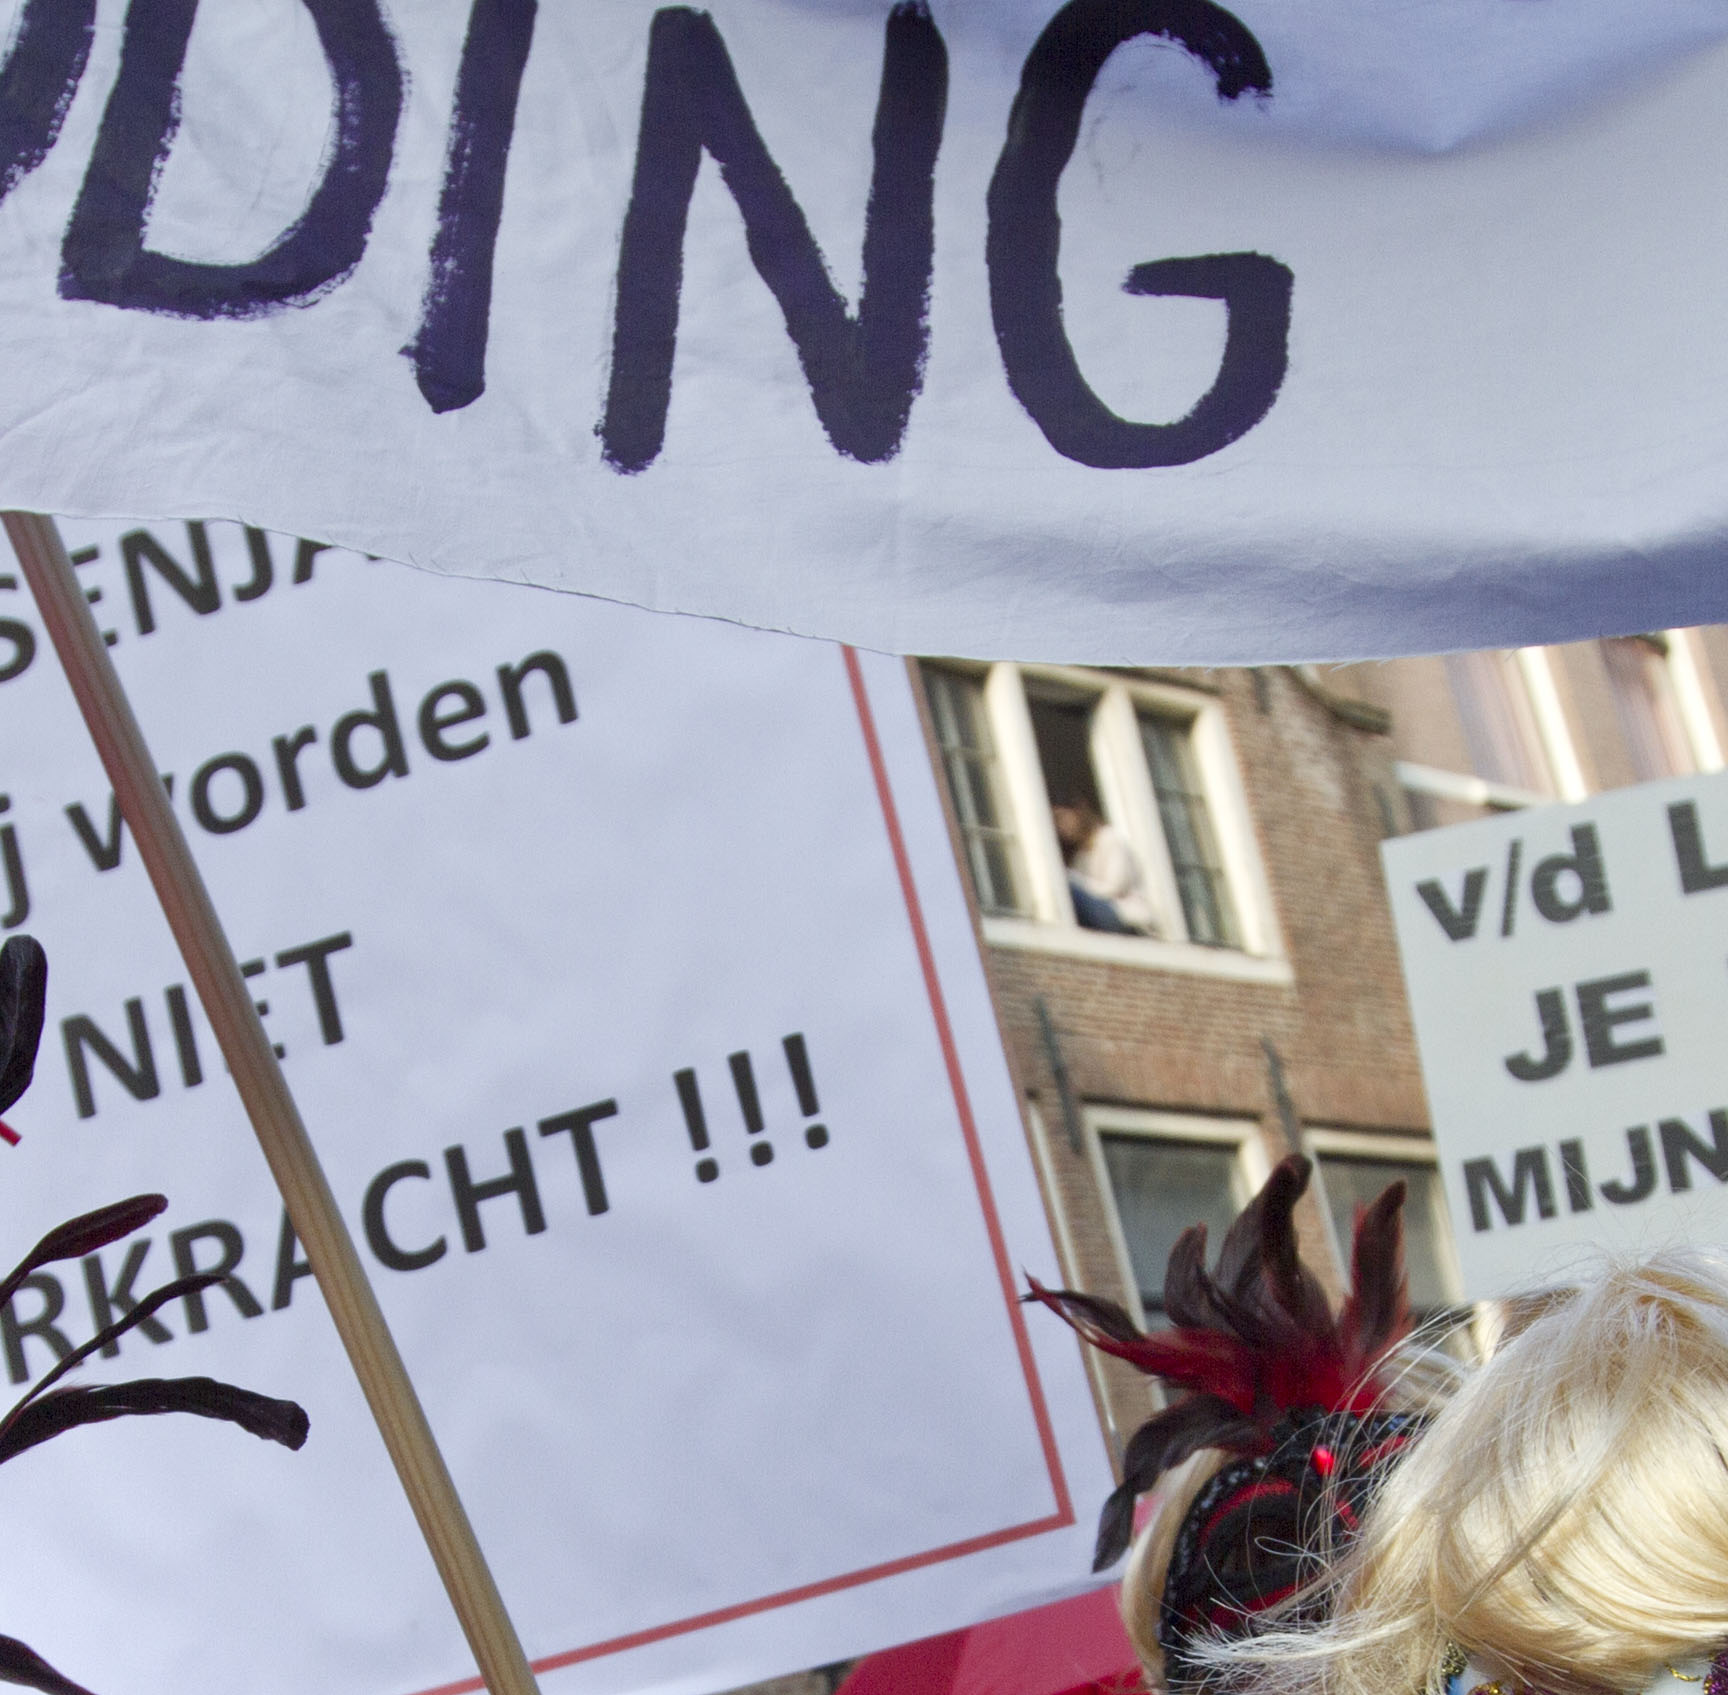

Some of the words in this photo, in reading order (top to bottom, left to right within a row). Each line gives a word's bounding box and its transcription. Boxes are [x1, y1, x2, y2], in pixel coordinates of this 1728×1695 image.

[1416, 821, 1611, 942] v/d
[60, 930, 353, 1119] NIT
[1504, 970, 1665, 1083] JE
